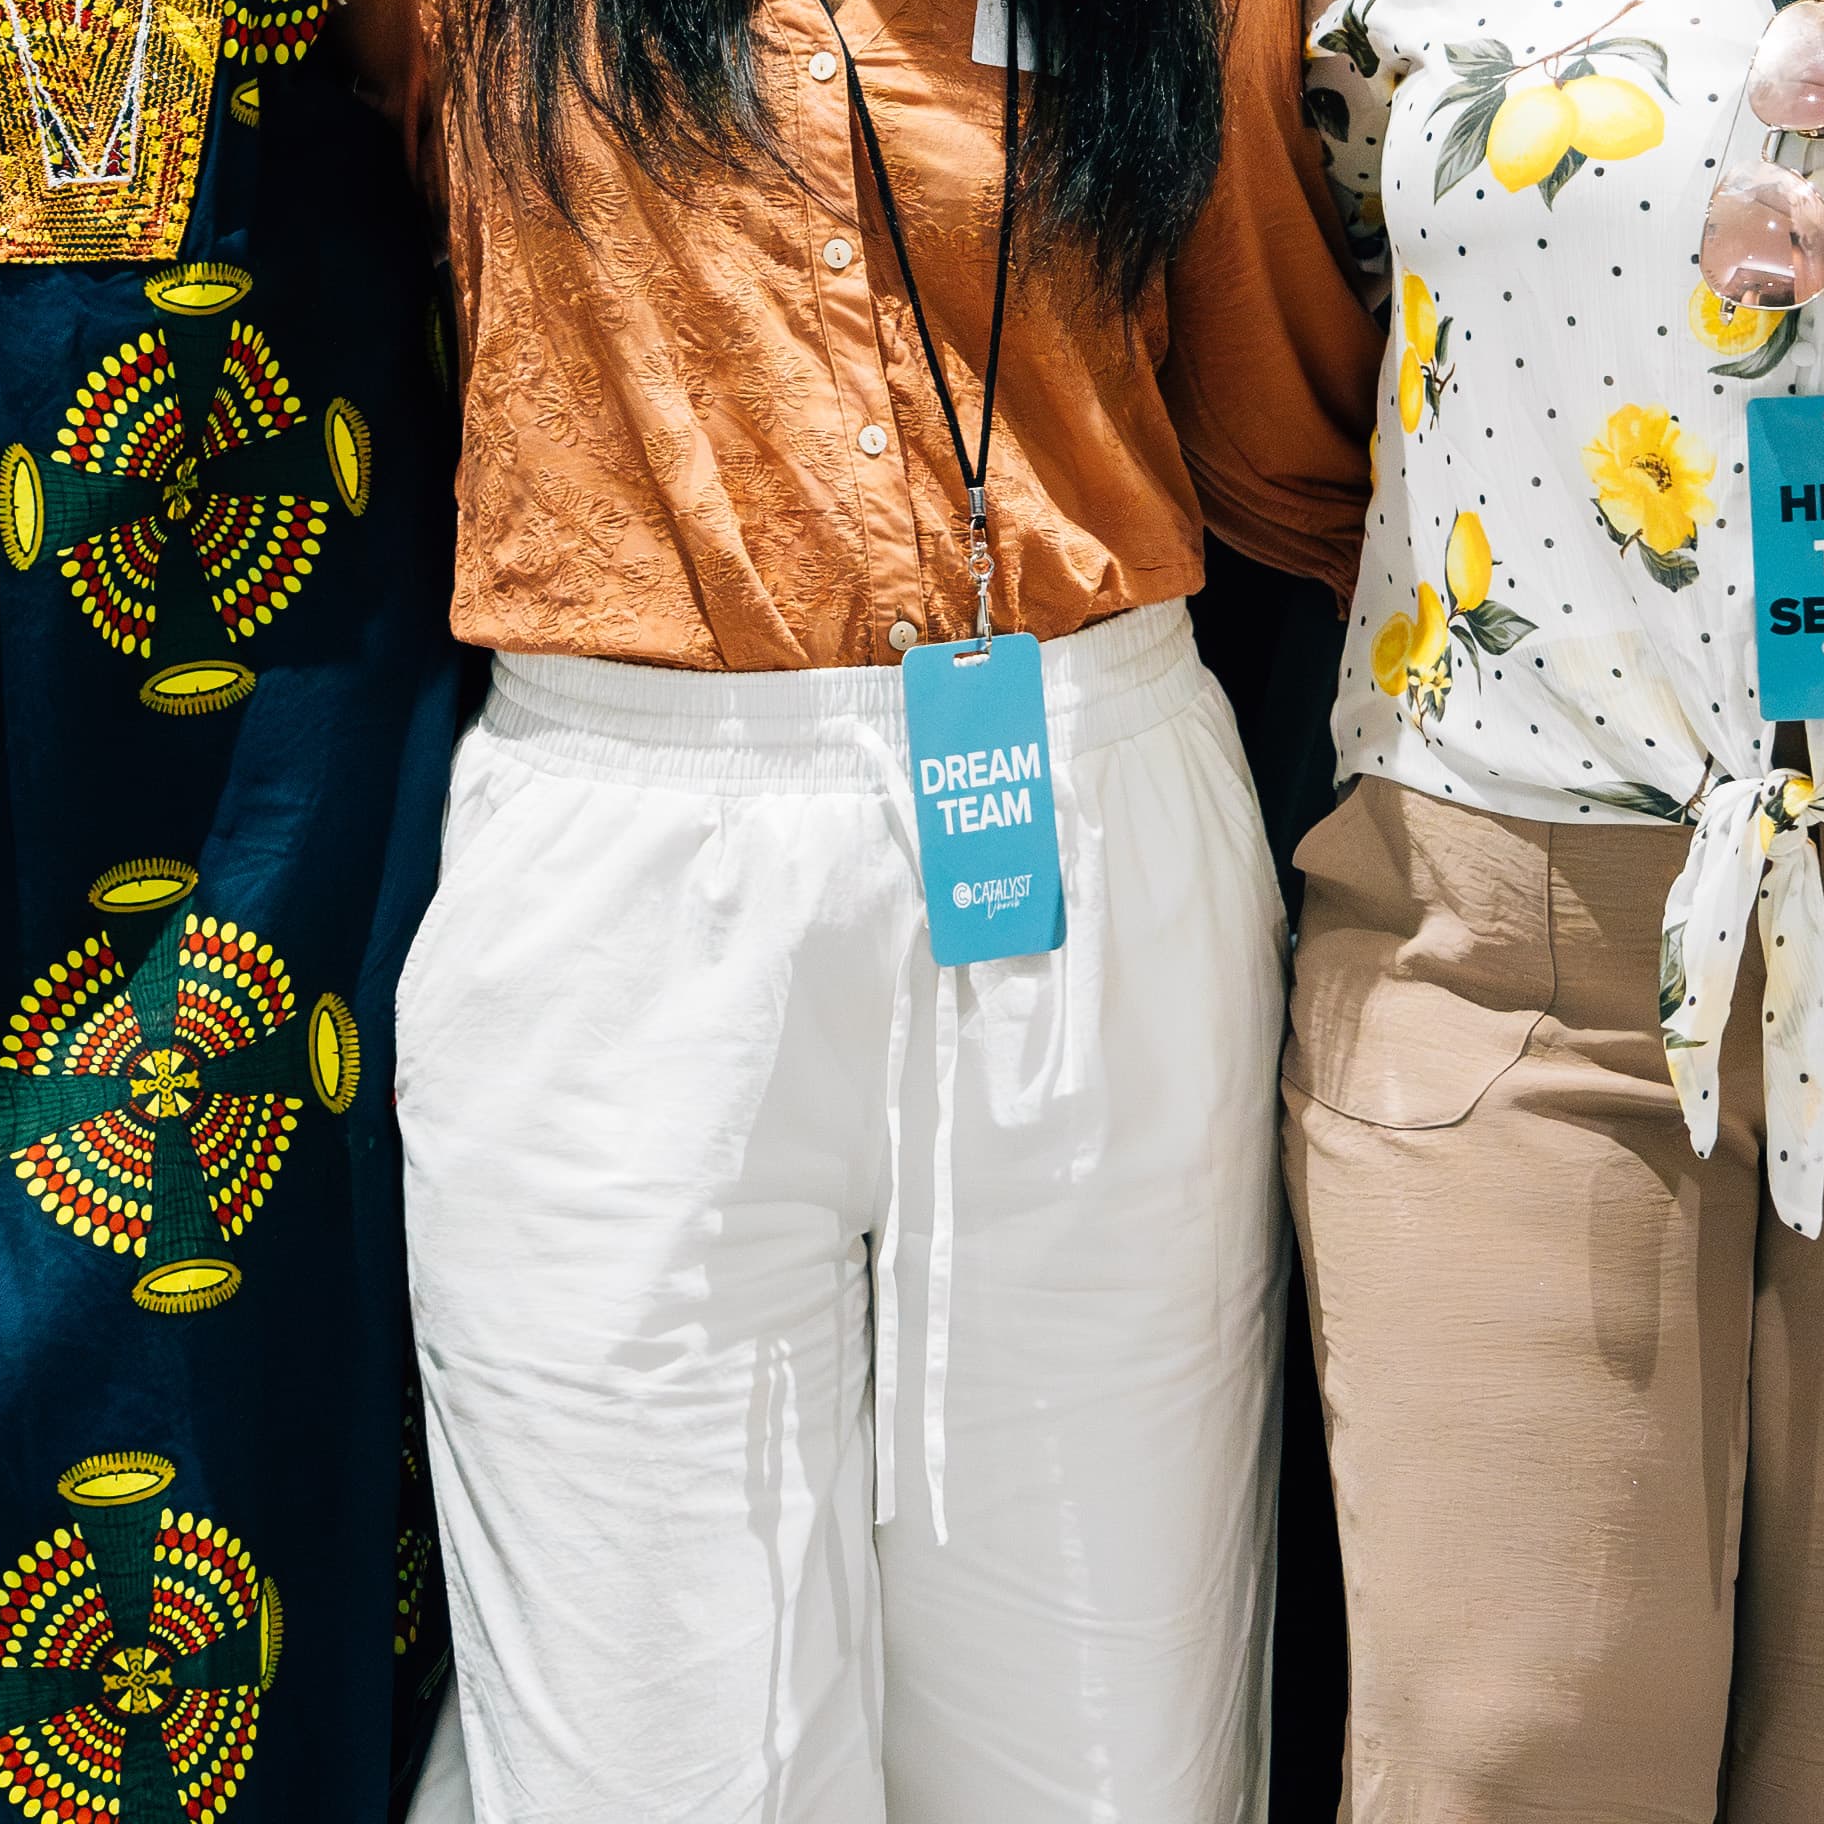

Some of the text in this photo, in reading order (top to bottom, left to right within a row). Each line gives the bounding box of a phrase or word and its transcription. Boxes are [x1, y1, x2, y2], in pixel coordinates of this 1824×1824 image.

[920, 742, 1041, 795] DREAM
[936, 788, 1033, 835] TEAM
[973, 873, 1033, 905] CATALYST
